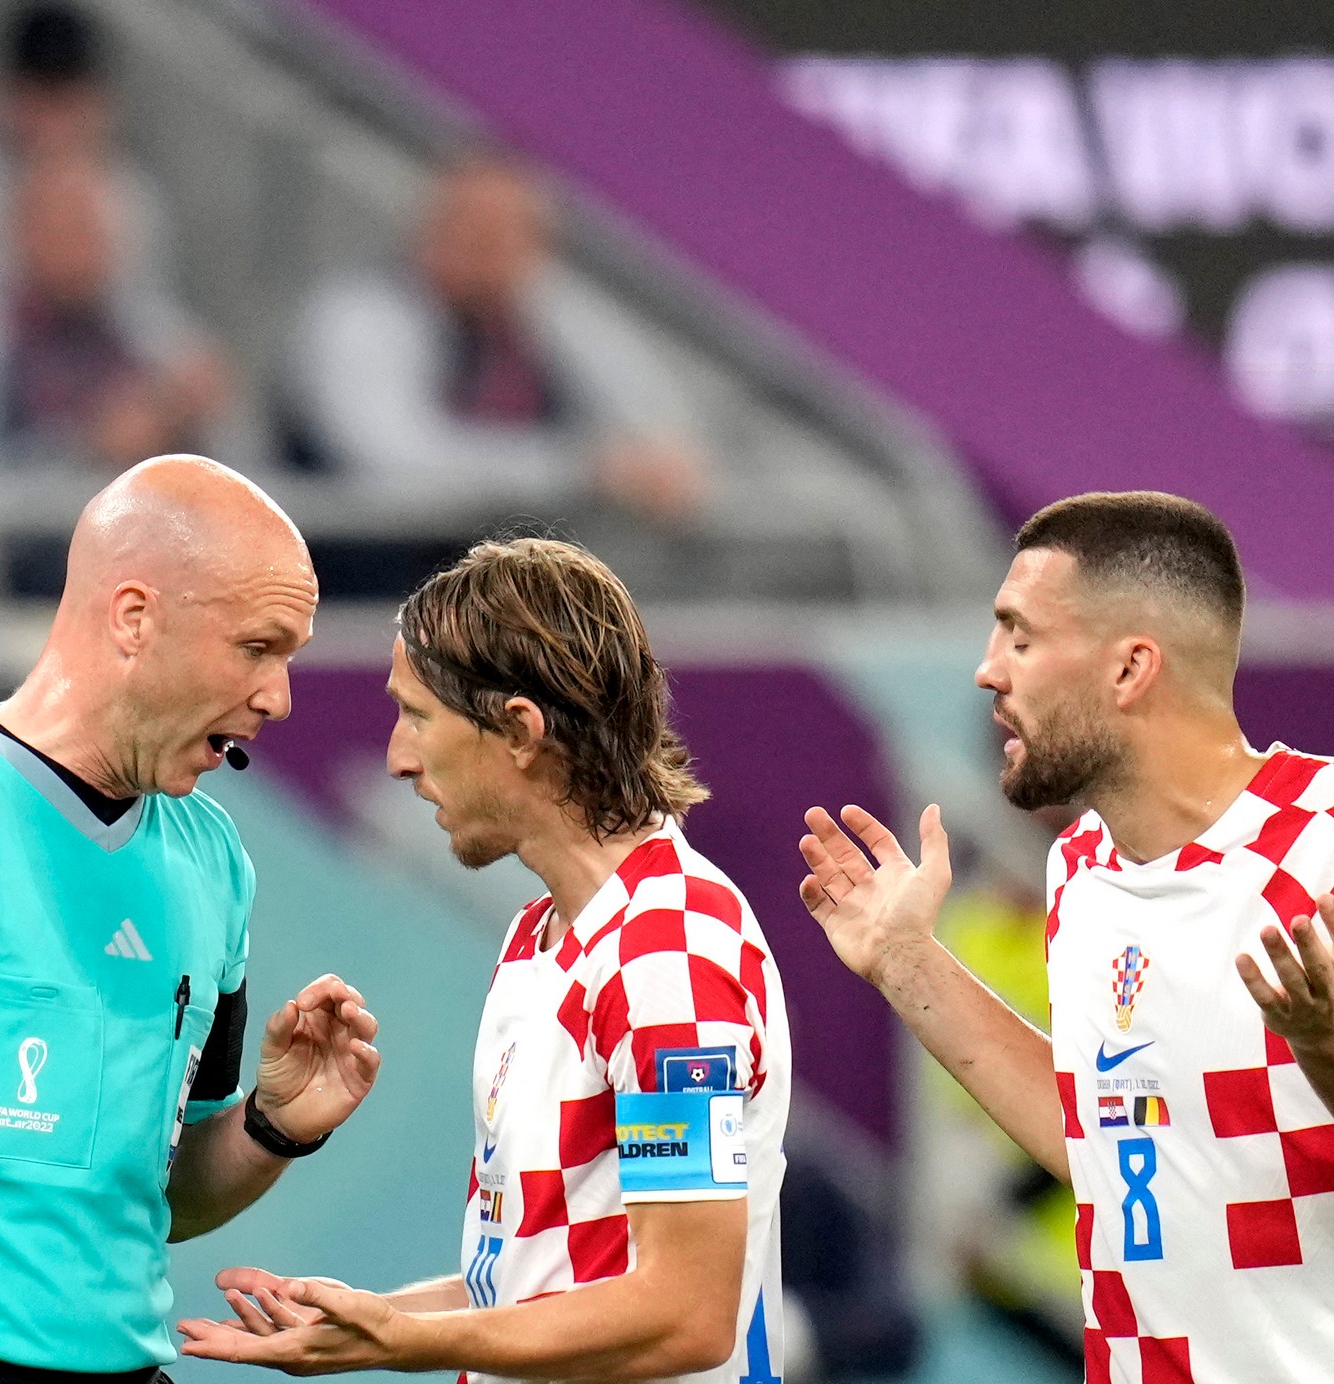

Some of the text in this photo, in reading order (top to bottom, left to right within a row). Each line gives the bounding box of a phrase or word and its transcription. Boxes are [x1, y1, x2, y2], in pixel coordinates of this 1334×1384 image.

[8, 1108, 41, 1120] WORLD
[41, 1113, 60, 1122] CUP
[616, 1122, 689, 1142] OTECT
[618, 1141, 688, 1159] ILDREN
[1117, 1138, 1163, 1262] 8
